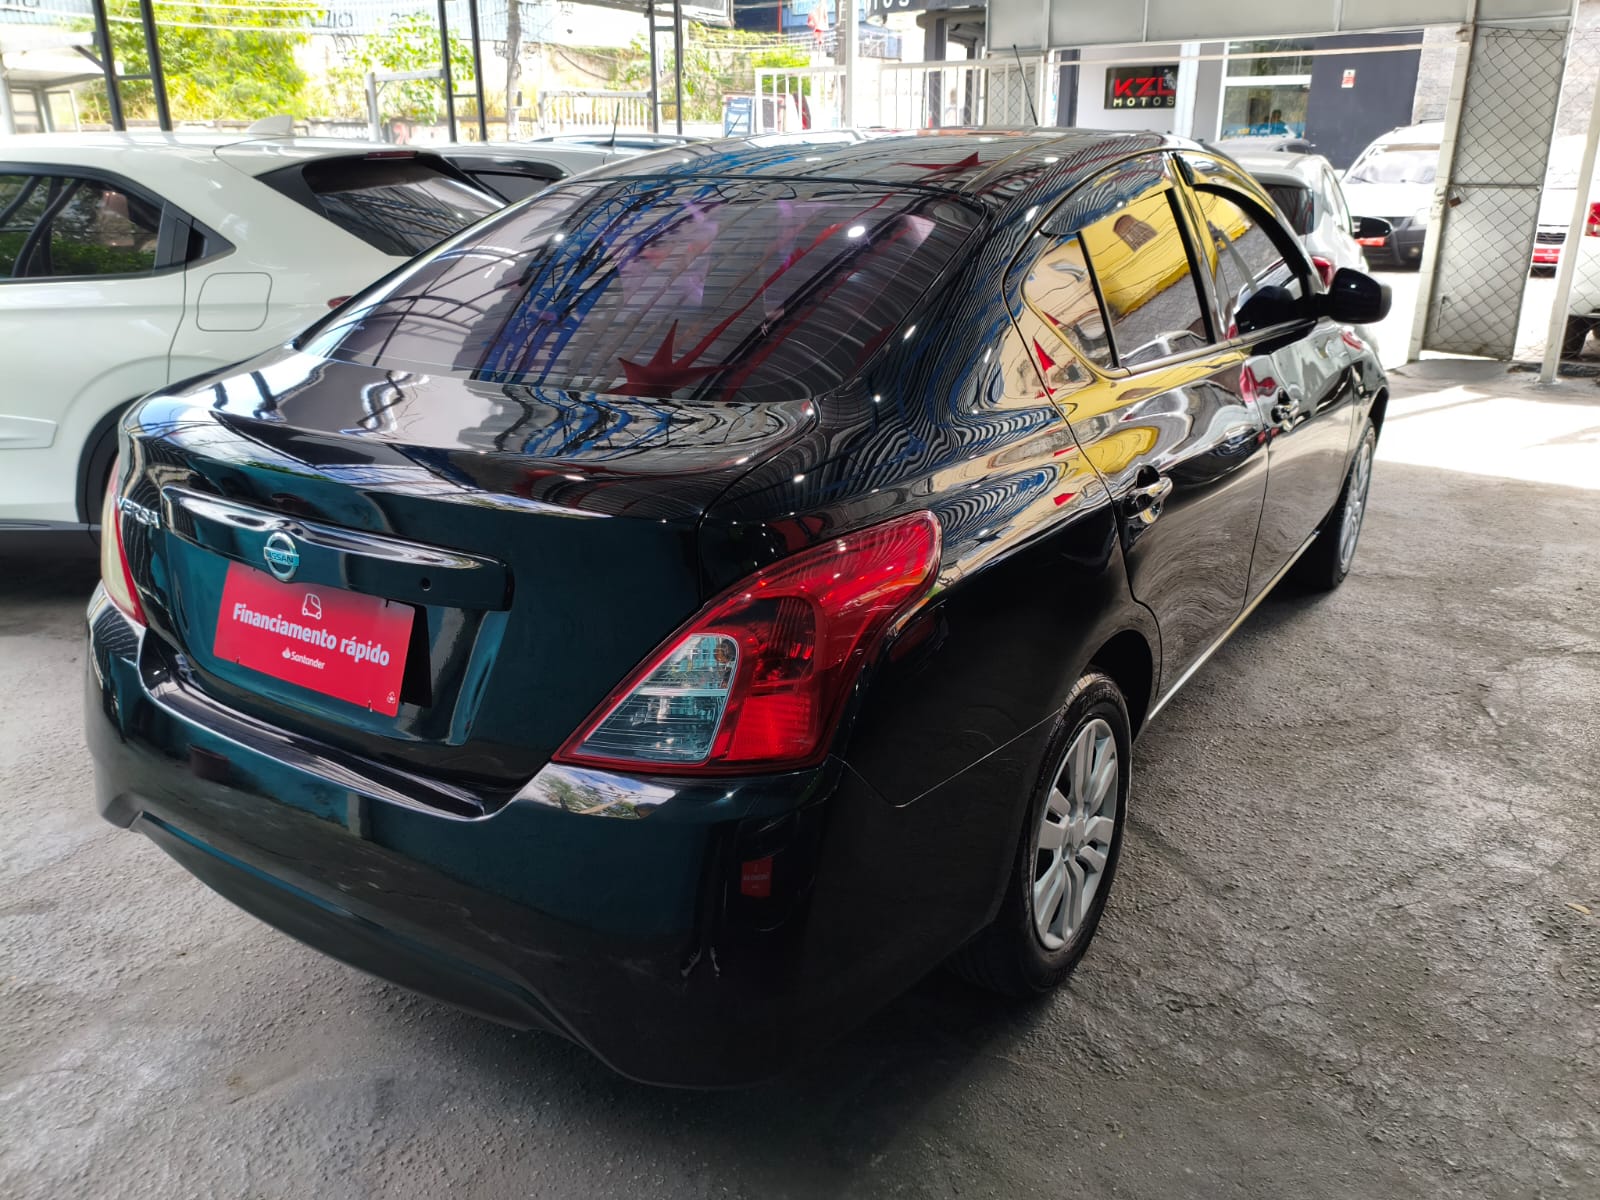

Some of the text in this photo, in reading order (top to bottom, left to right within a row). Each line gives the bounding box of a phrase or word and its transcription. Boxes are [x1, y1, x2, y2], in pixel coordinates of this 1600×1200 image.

[1114, 77, 1176, 97] KZL
[1113, 97, 1175, 107] MOTOS
[117, 496, 160, 529] VERSA
[233, 602, 390, 667] Financiamento rápido
[290, 651, 326, 669] Santander
